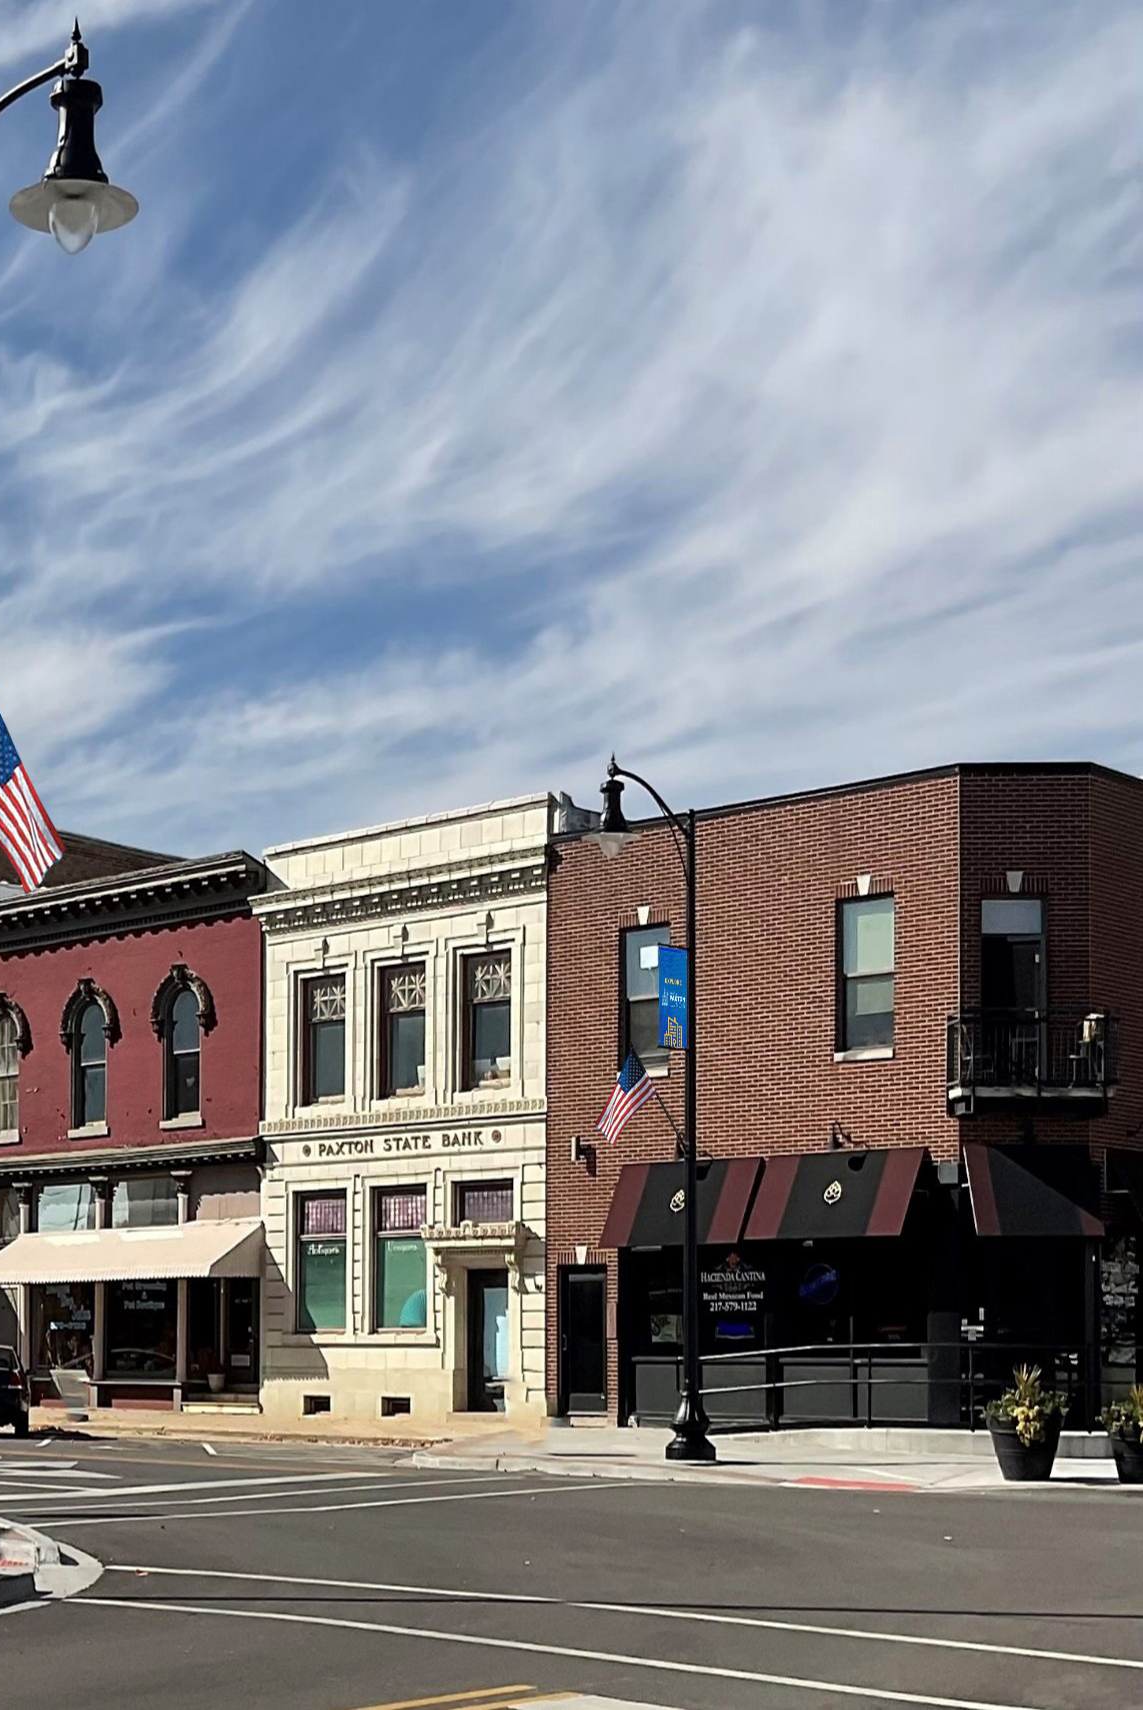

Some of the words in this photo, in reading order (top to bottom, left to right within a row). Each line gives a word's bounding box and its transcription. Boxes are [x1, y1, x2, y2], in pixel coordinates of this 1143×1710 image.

[318, 1139, 374, 1157] PAXTON
[383, 1135, 432, 1152] STATE
[441, 1131, 484, 1148] BANK
